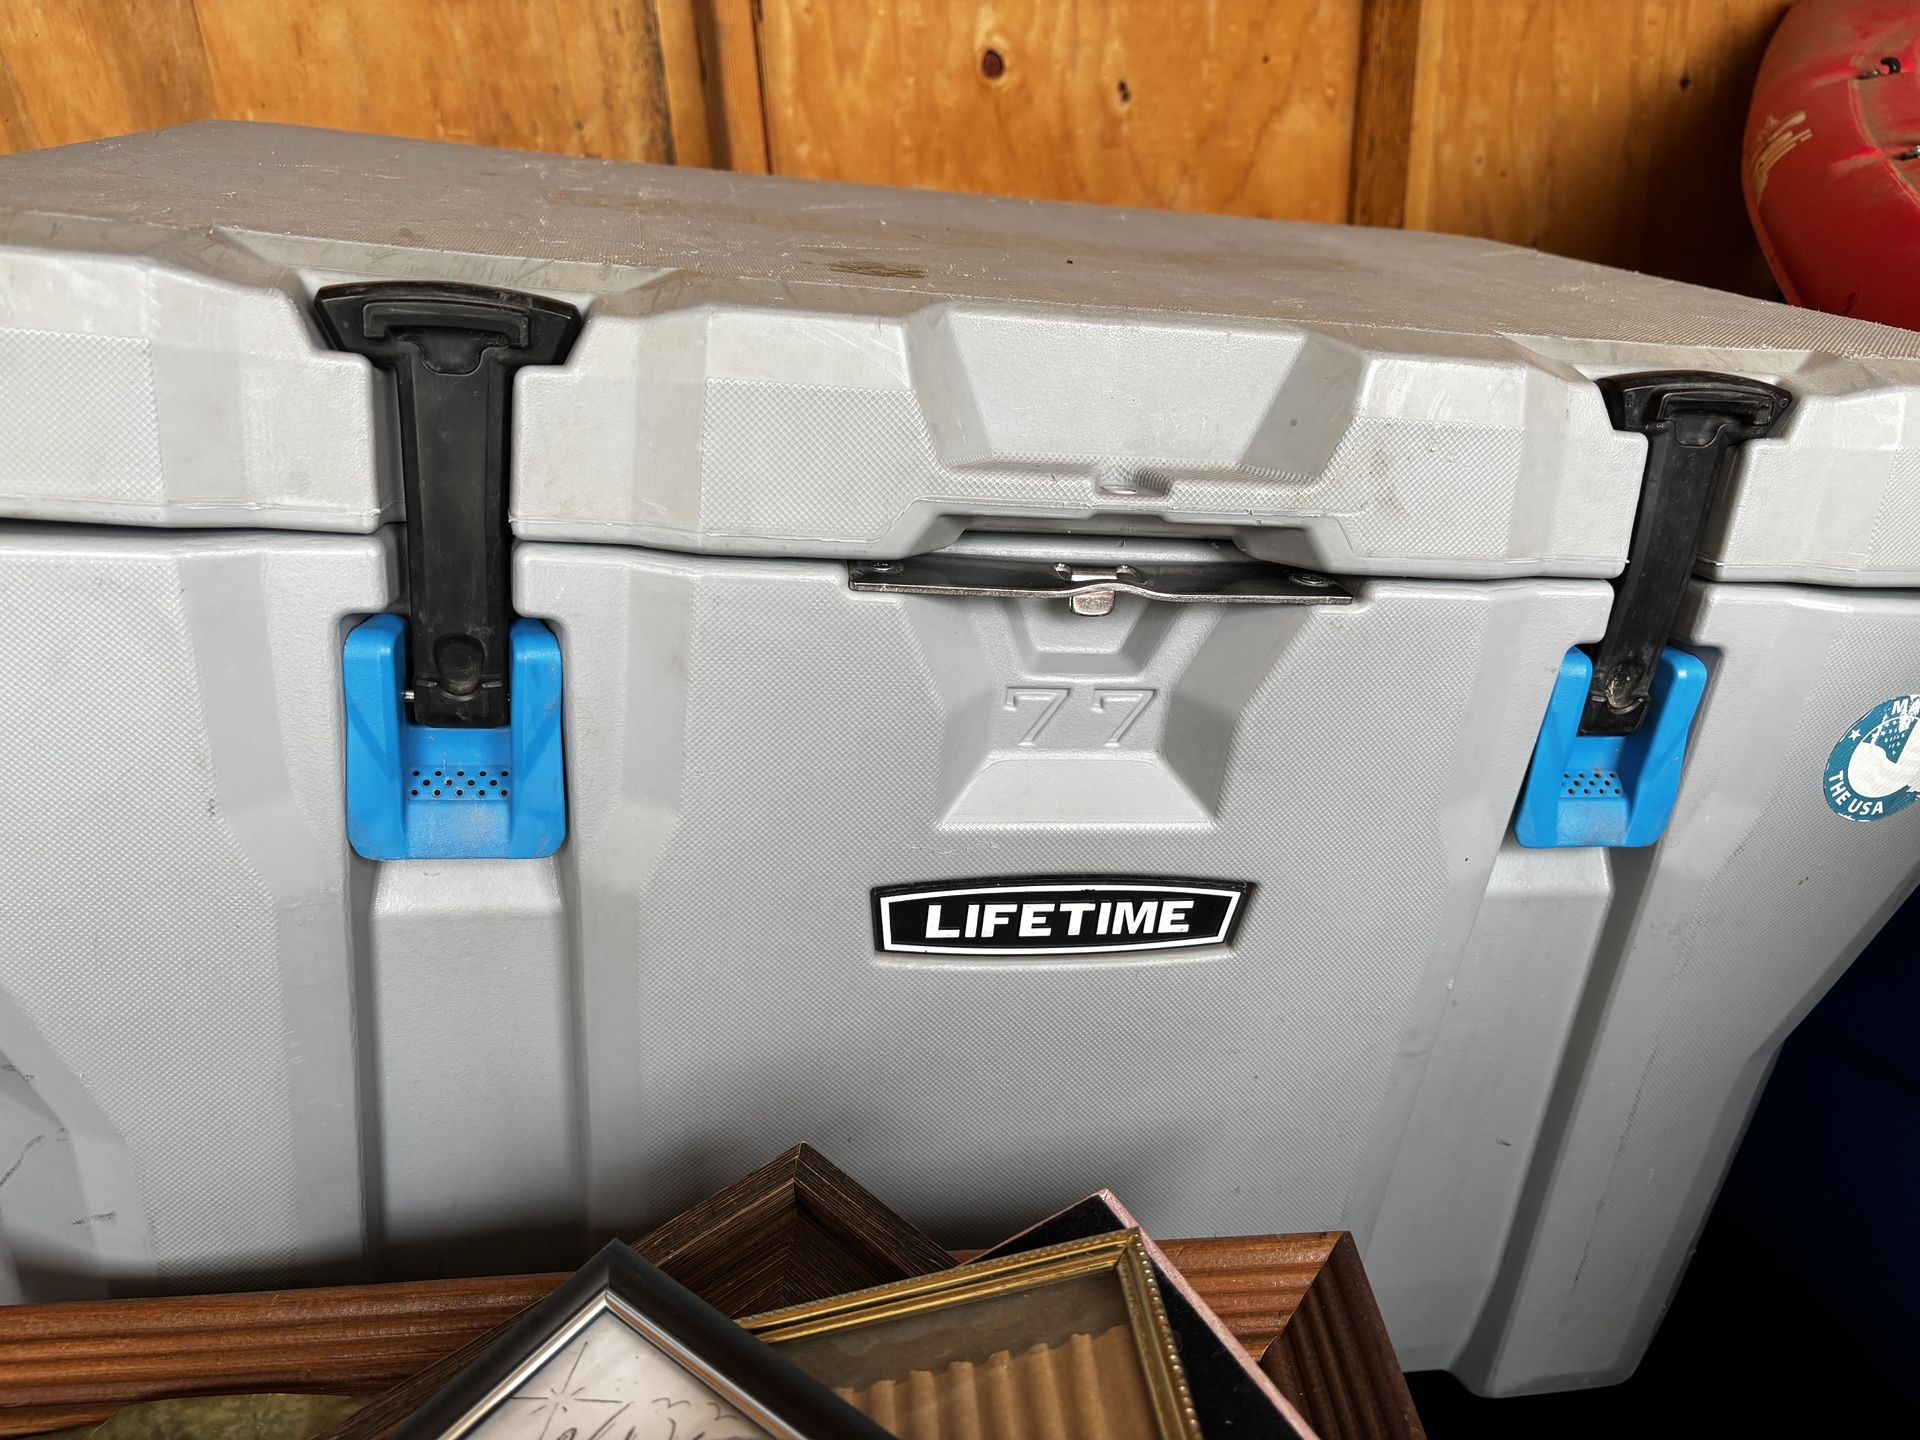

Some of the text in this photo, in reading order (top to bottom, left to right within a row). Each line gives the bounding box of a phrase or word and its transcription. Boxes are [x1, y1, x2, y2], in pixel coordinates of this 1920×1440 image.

[1829, 770, 1883, 815] THE USA
[925, 900, 1194, 938] LIFETIME
